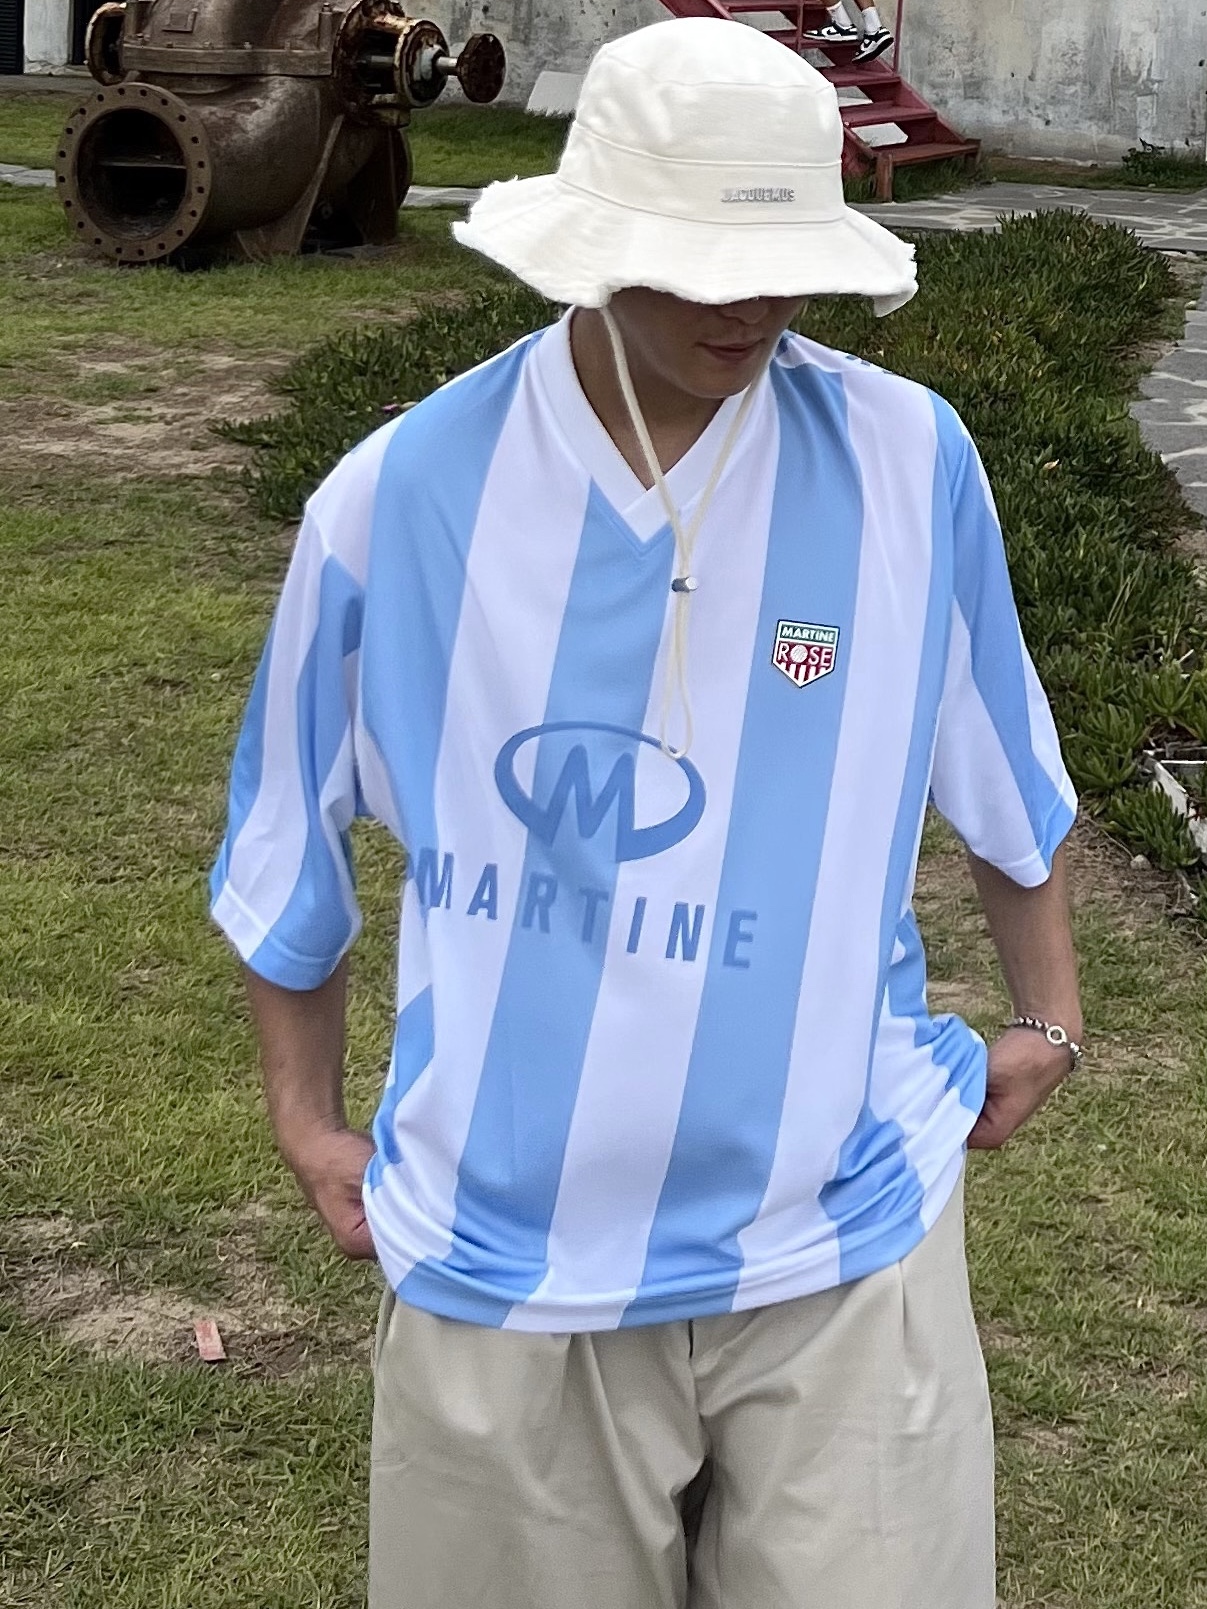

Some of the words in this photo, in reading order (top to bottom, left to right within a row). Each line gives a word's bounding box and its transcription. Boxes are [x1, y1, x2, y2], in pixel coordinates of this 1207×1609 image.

[781, 626, 835, 642] MARTINE
[777, 642, 833, 667] ROSE
[415, 846, 759, 969] MARTINE
